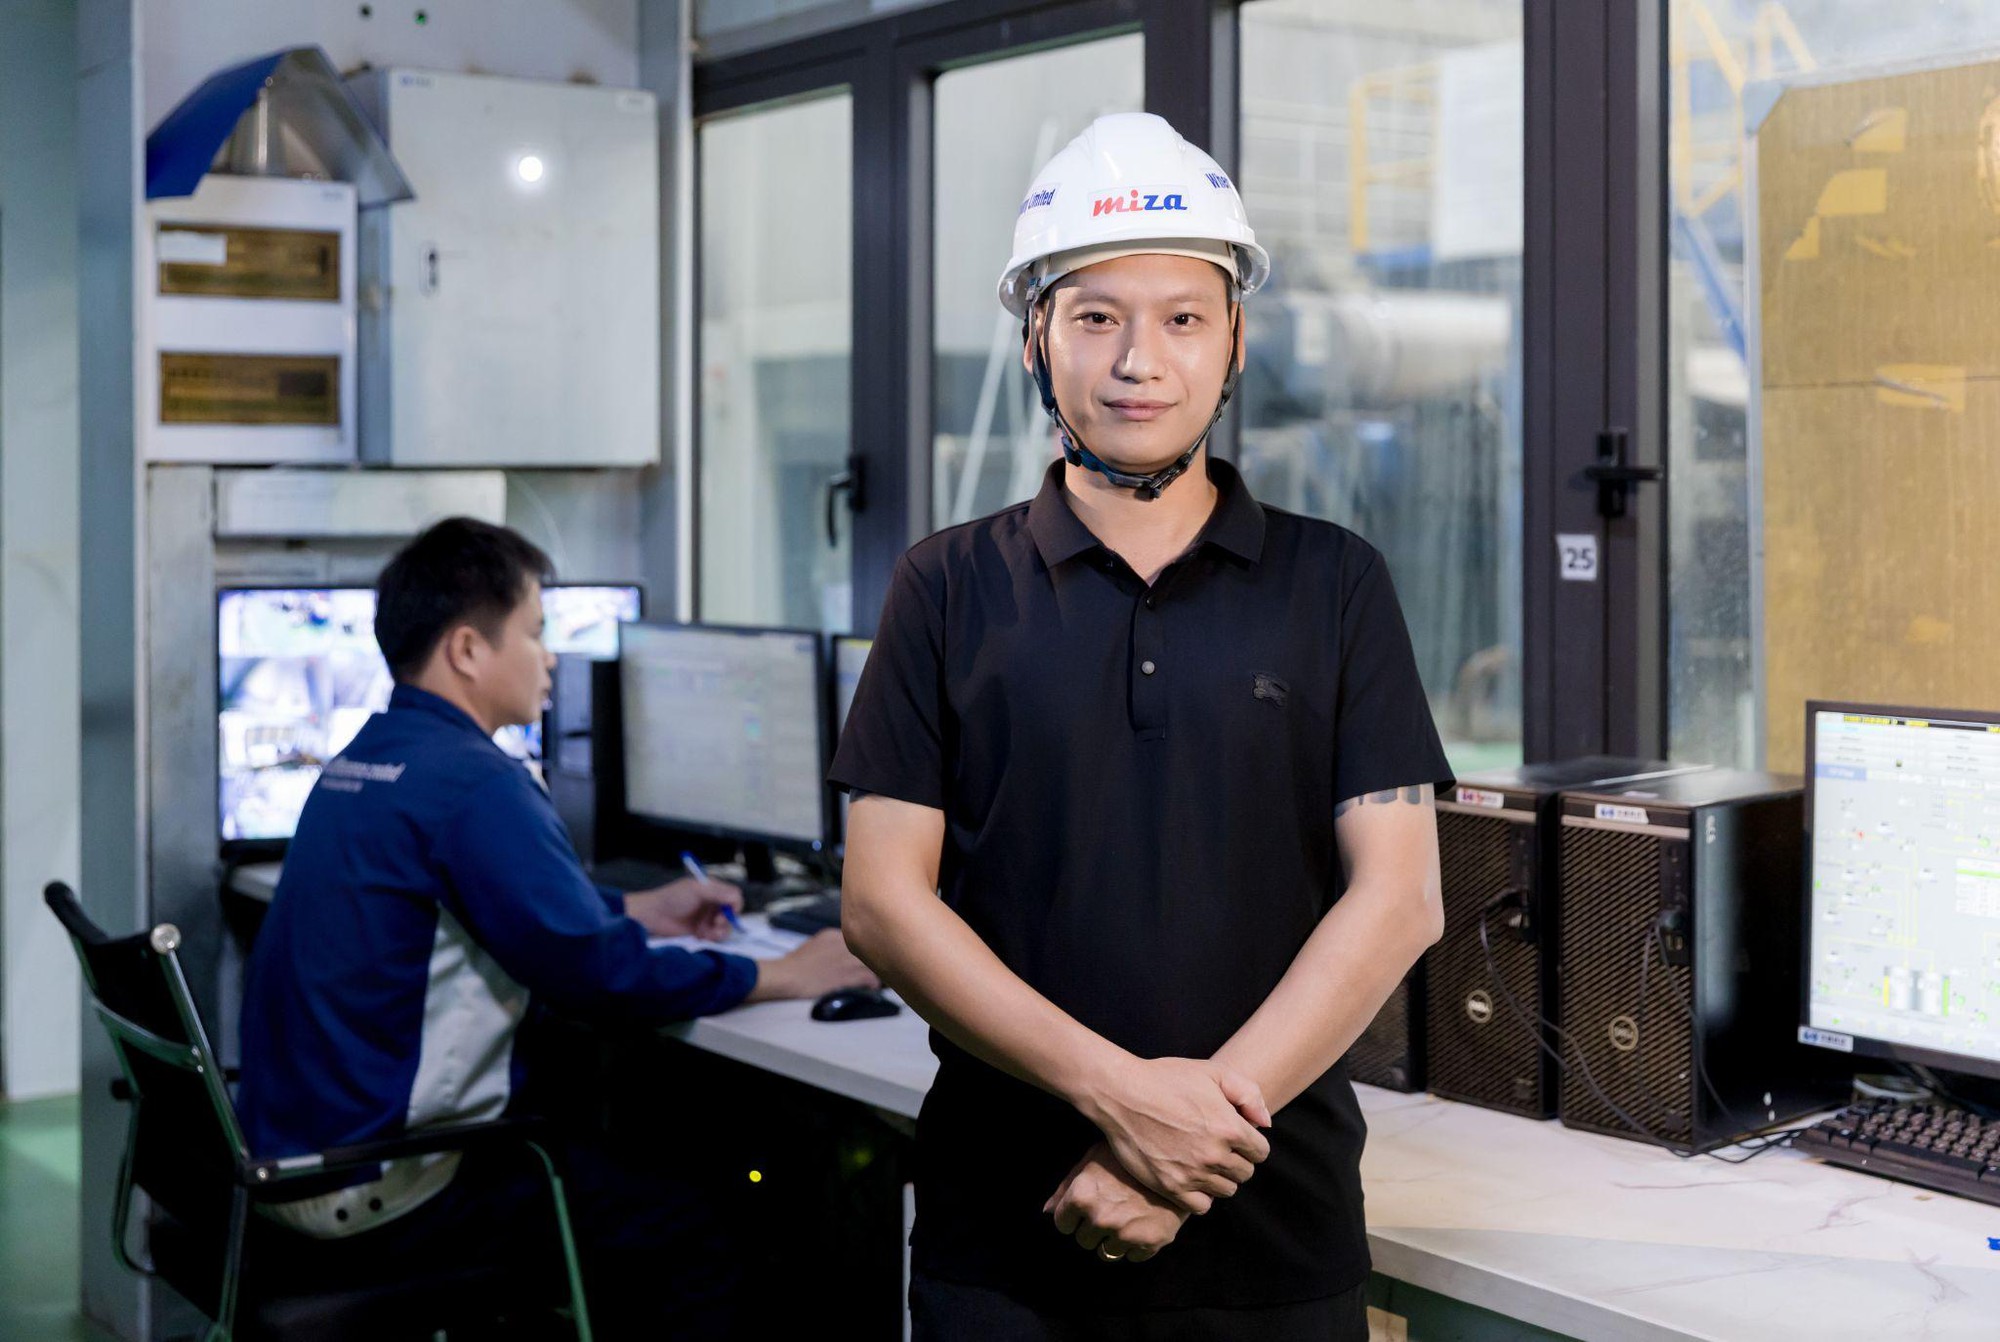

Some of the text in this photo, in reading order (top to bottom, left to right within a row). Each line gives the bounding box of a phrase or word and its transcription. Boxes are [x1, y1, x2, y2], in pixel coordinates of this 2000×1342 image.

[1028, 188, 1055, 209] Limited
[1093, 189, 1188, 217] miza
[1567, 547, 1594, 570] 25
